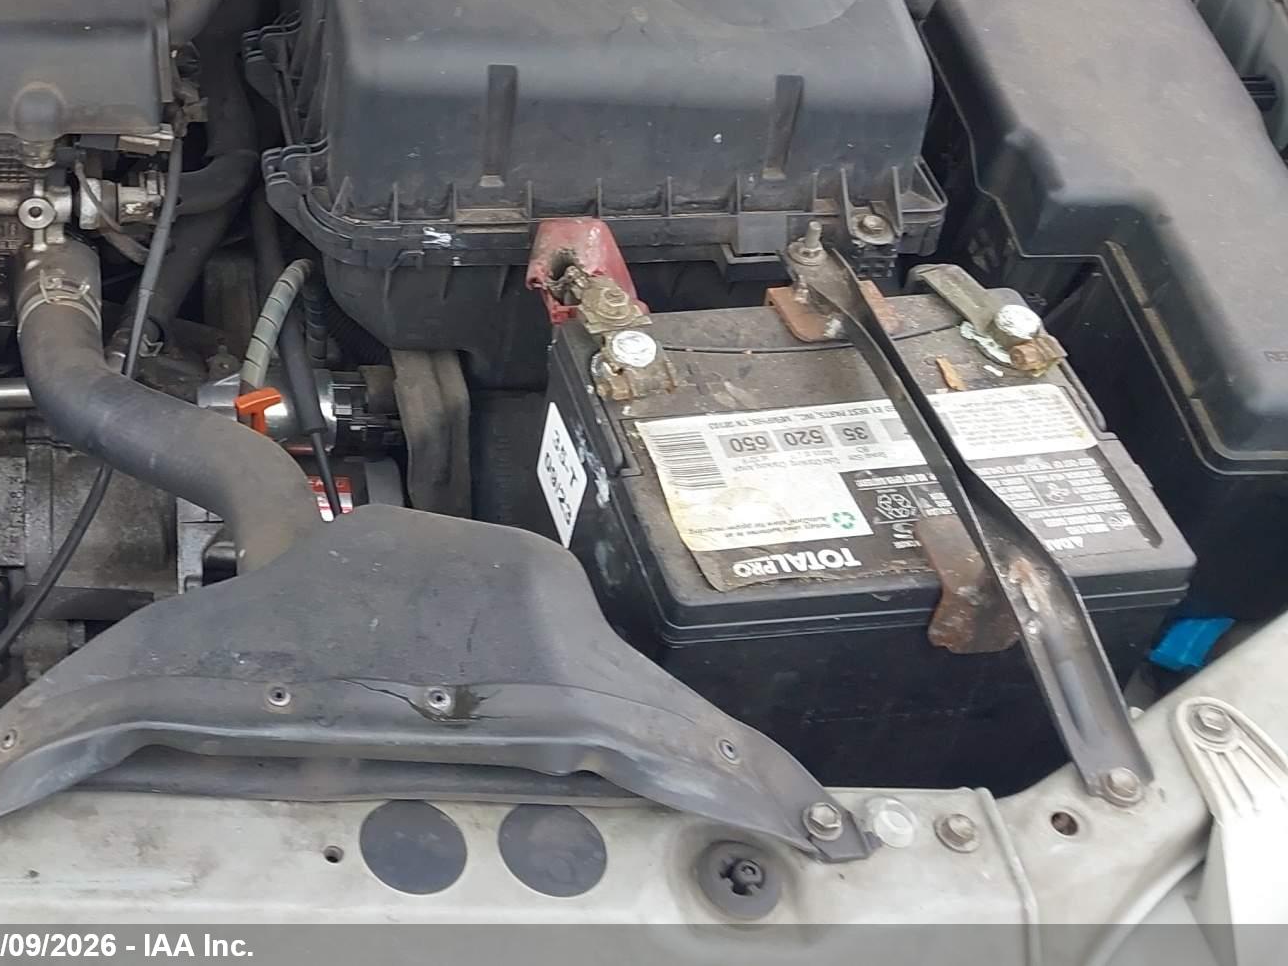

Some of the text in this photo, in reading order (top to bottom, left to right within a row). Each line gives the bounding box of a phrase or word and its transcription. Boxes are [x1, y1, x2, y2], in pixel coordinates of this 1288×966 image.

[784, 429, 824, 446] 520
[842, 426, 868, 441] 35
[729, 435, 769, 452] 650
[732, 547, 862, 578] TOTALPRO
